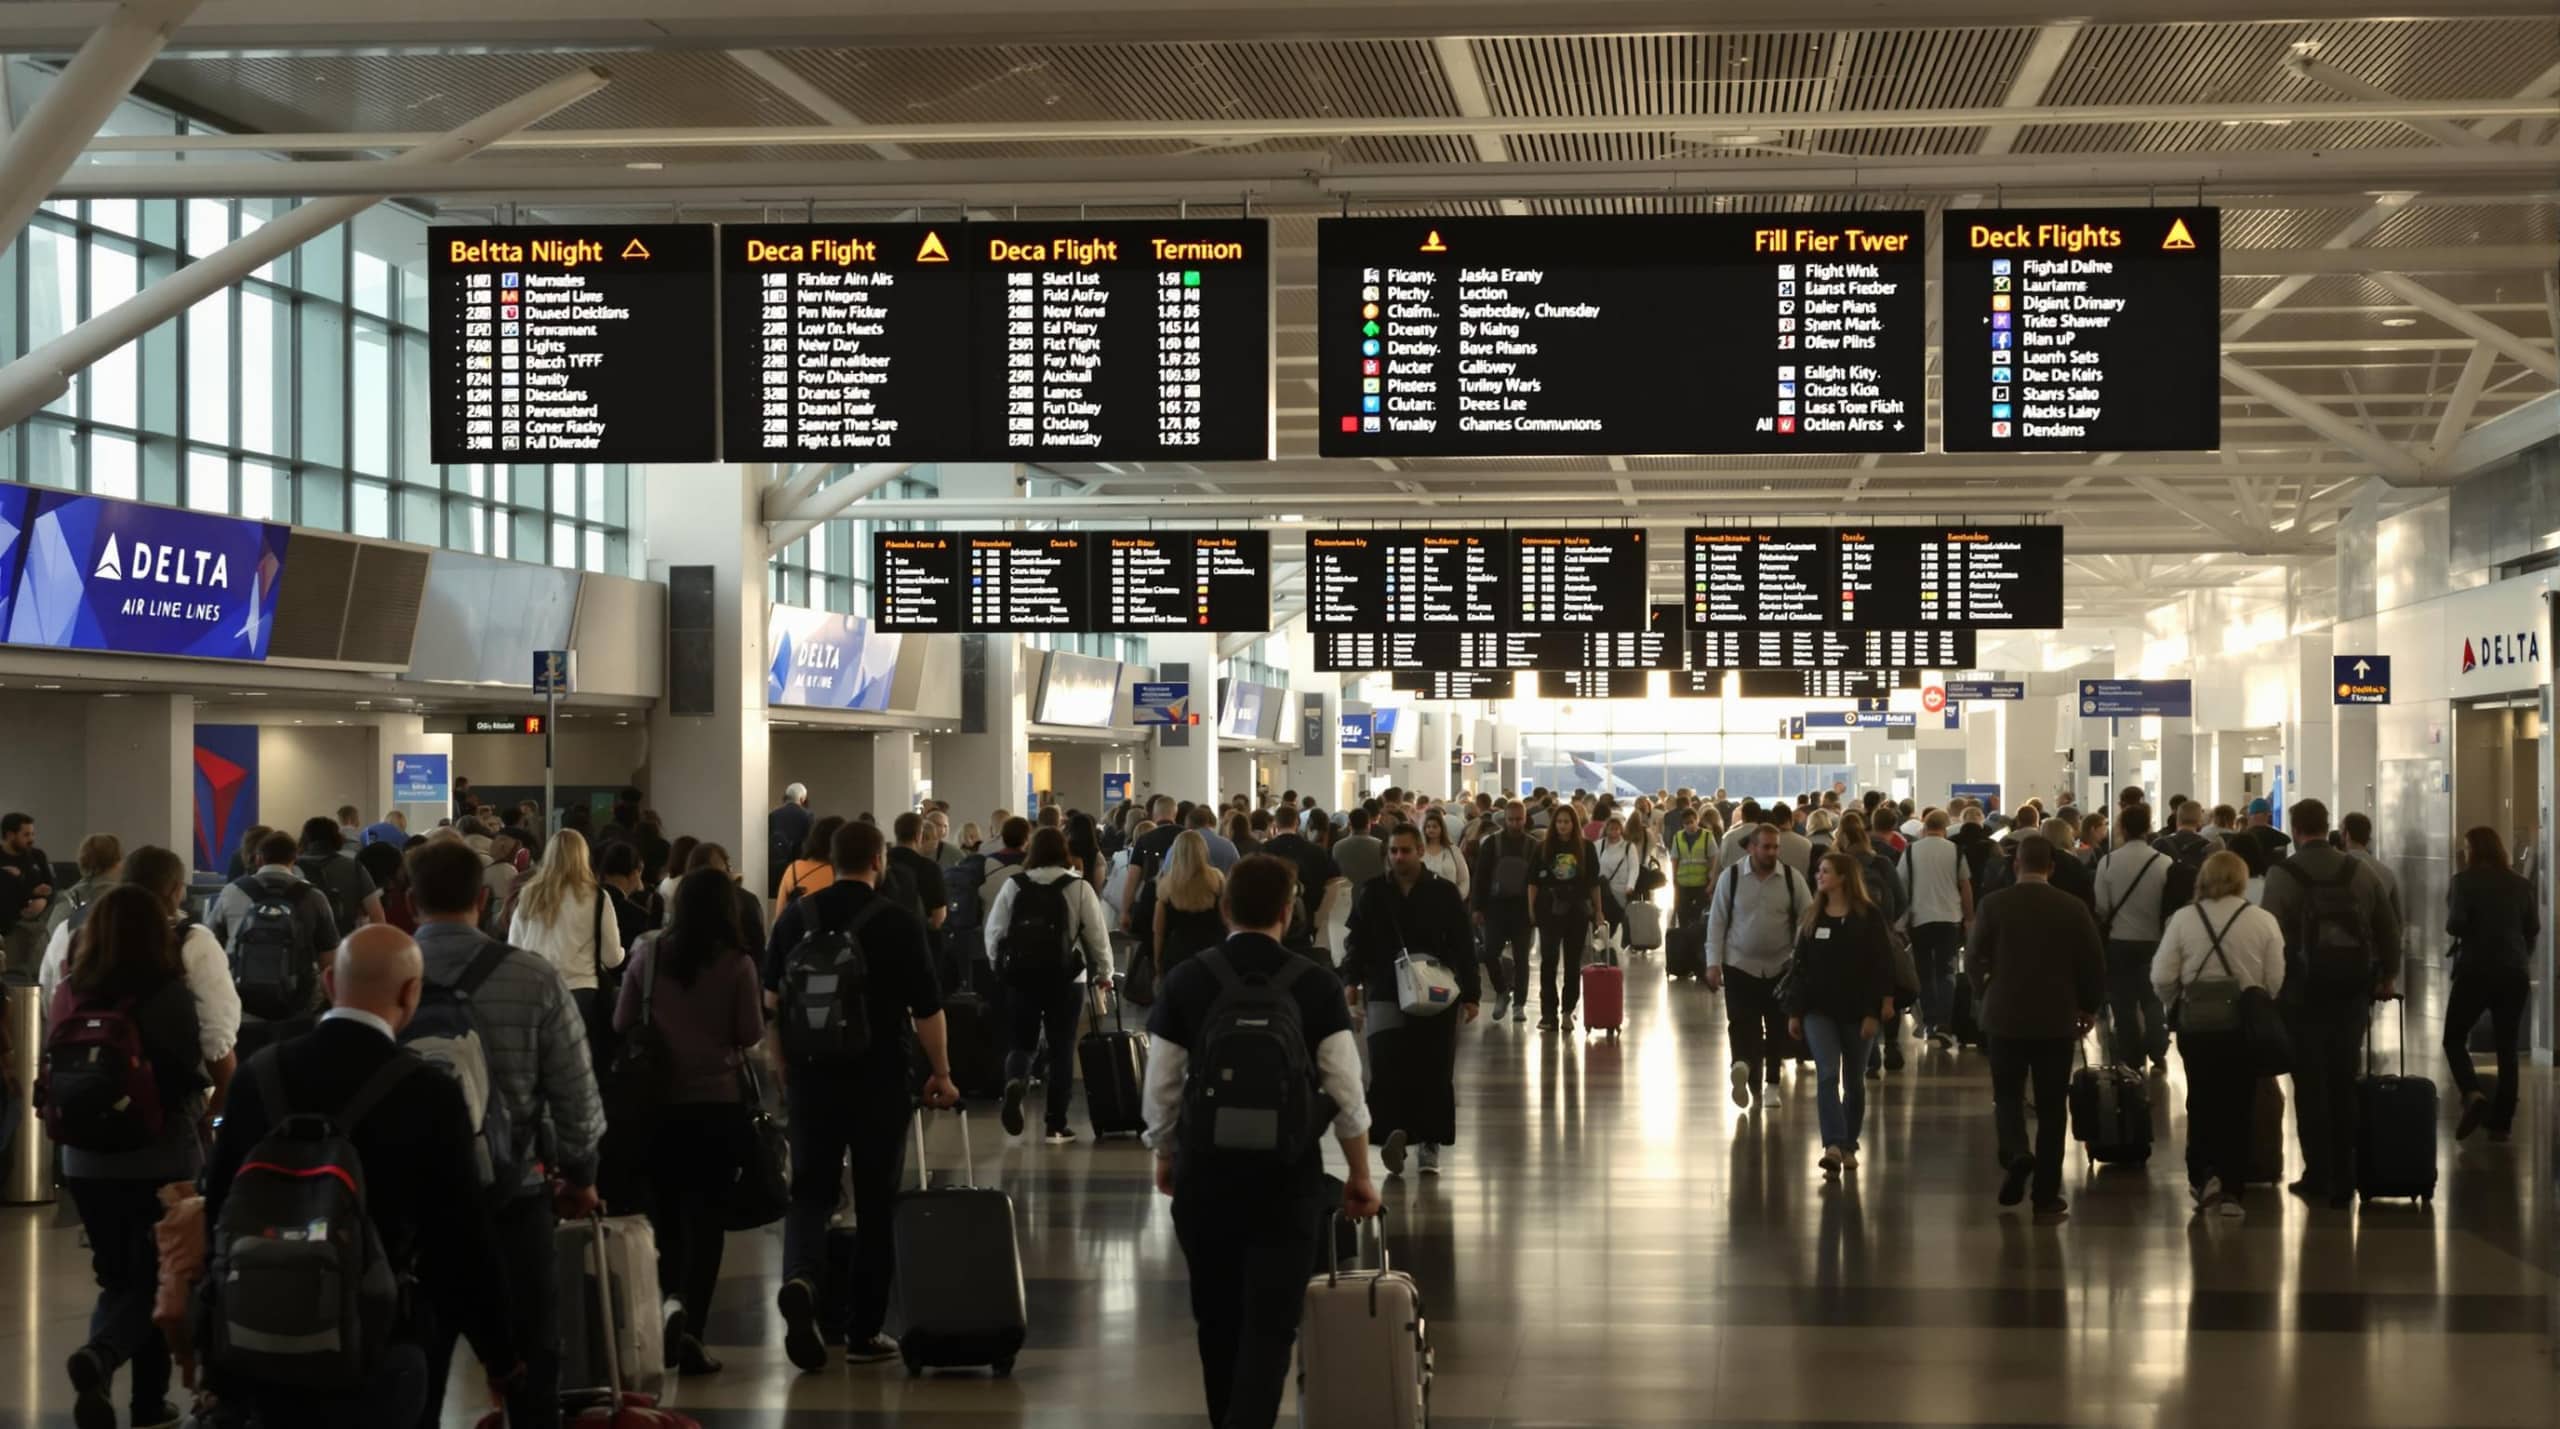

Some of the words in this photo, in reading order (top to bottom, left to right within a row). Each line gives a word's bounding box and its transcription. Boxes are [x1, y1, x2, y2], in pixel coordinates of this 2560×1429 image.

[1756, 229, 1787, 251] Fill
[1795, 230, 1839, 251] Fier
[1971, 225, 2031, 248] Deck
[2039, 224, 2121, 252] Flights
[451, 240, 523, 262] Beltta
[532, 239, 602, 266] Nlight
[748, 240, 803, 261] Deca
[811, 239, 876, 266] Flight
[990, 240, 1045, 261] Deca
[1054, 238, 1117, 265] Flight
[1806, 263, 1844, 280] Flight
[1460, 322, 1477, 338] By
[833, 338, 859, 353] Day
[1043, 401, 1065, 414] Fun
[1756, 417, 1773, 431] All
[132, 542, 227, 589] DELTA
[121, 598, 145, 615] AIR
[150, 600, 182, 618] LINE
[797, 643, 840, 670] DELTA
[2481, 632, 2539, 665] DELTA
